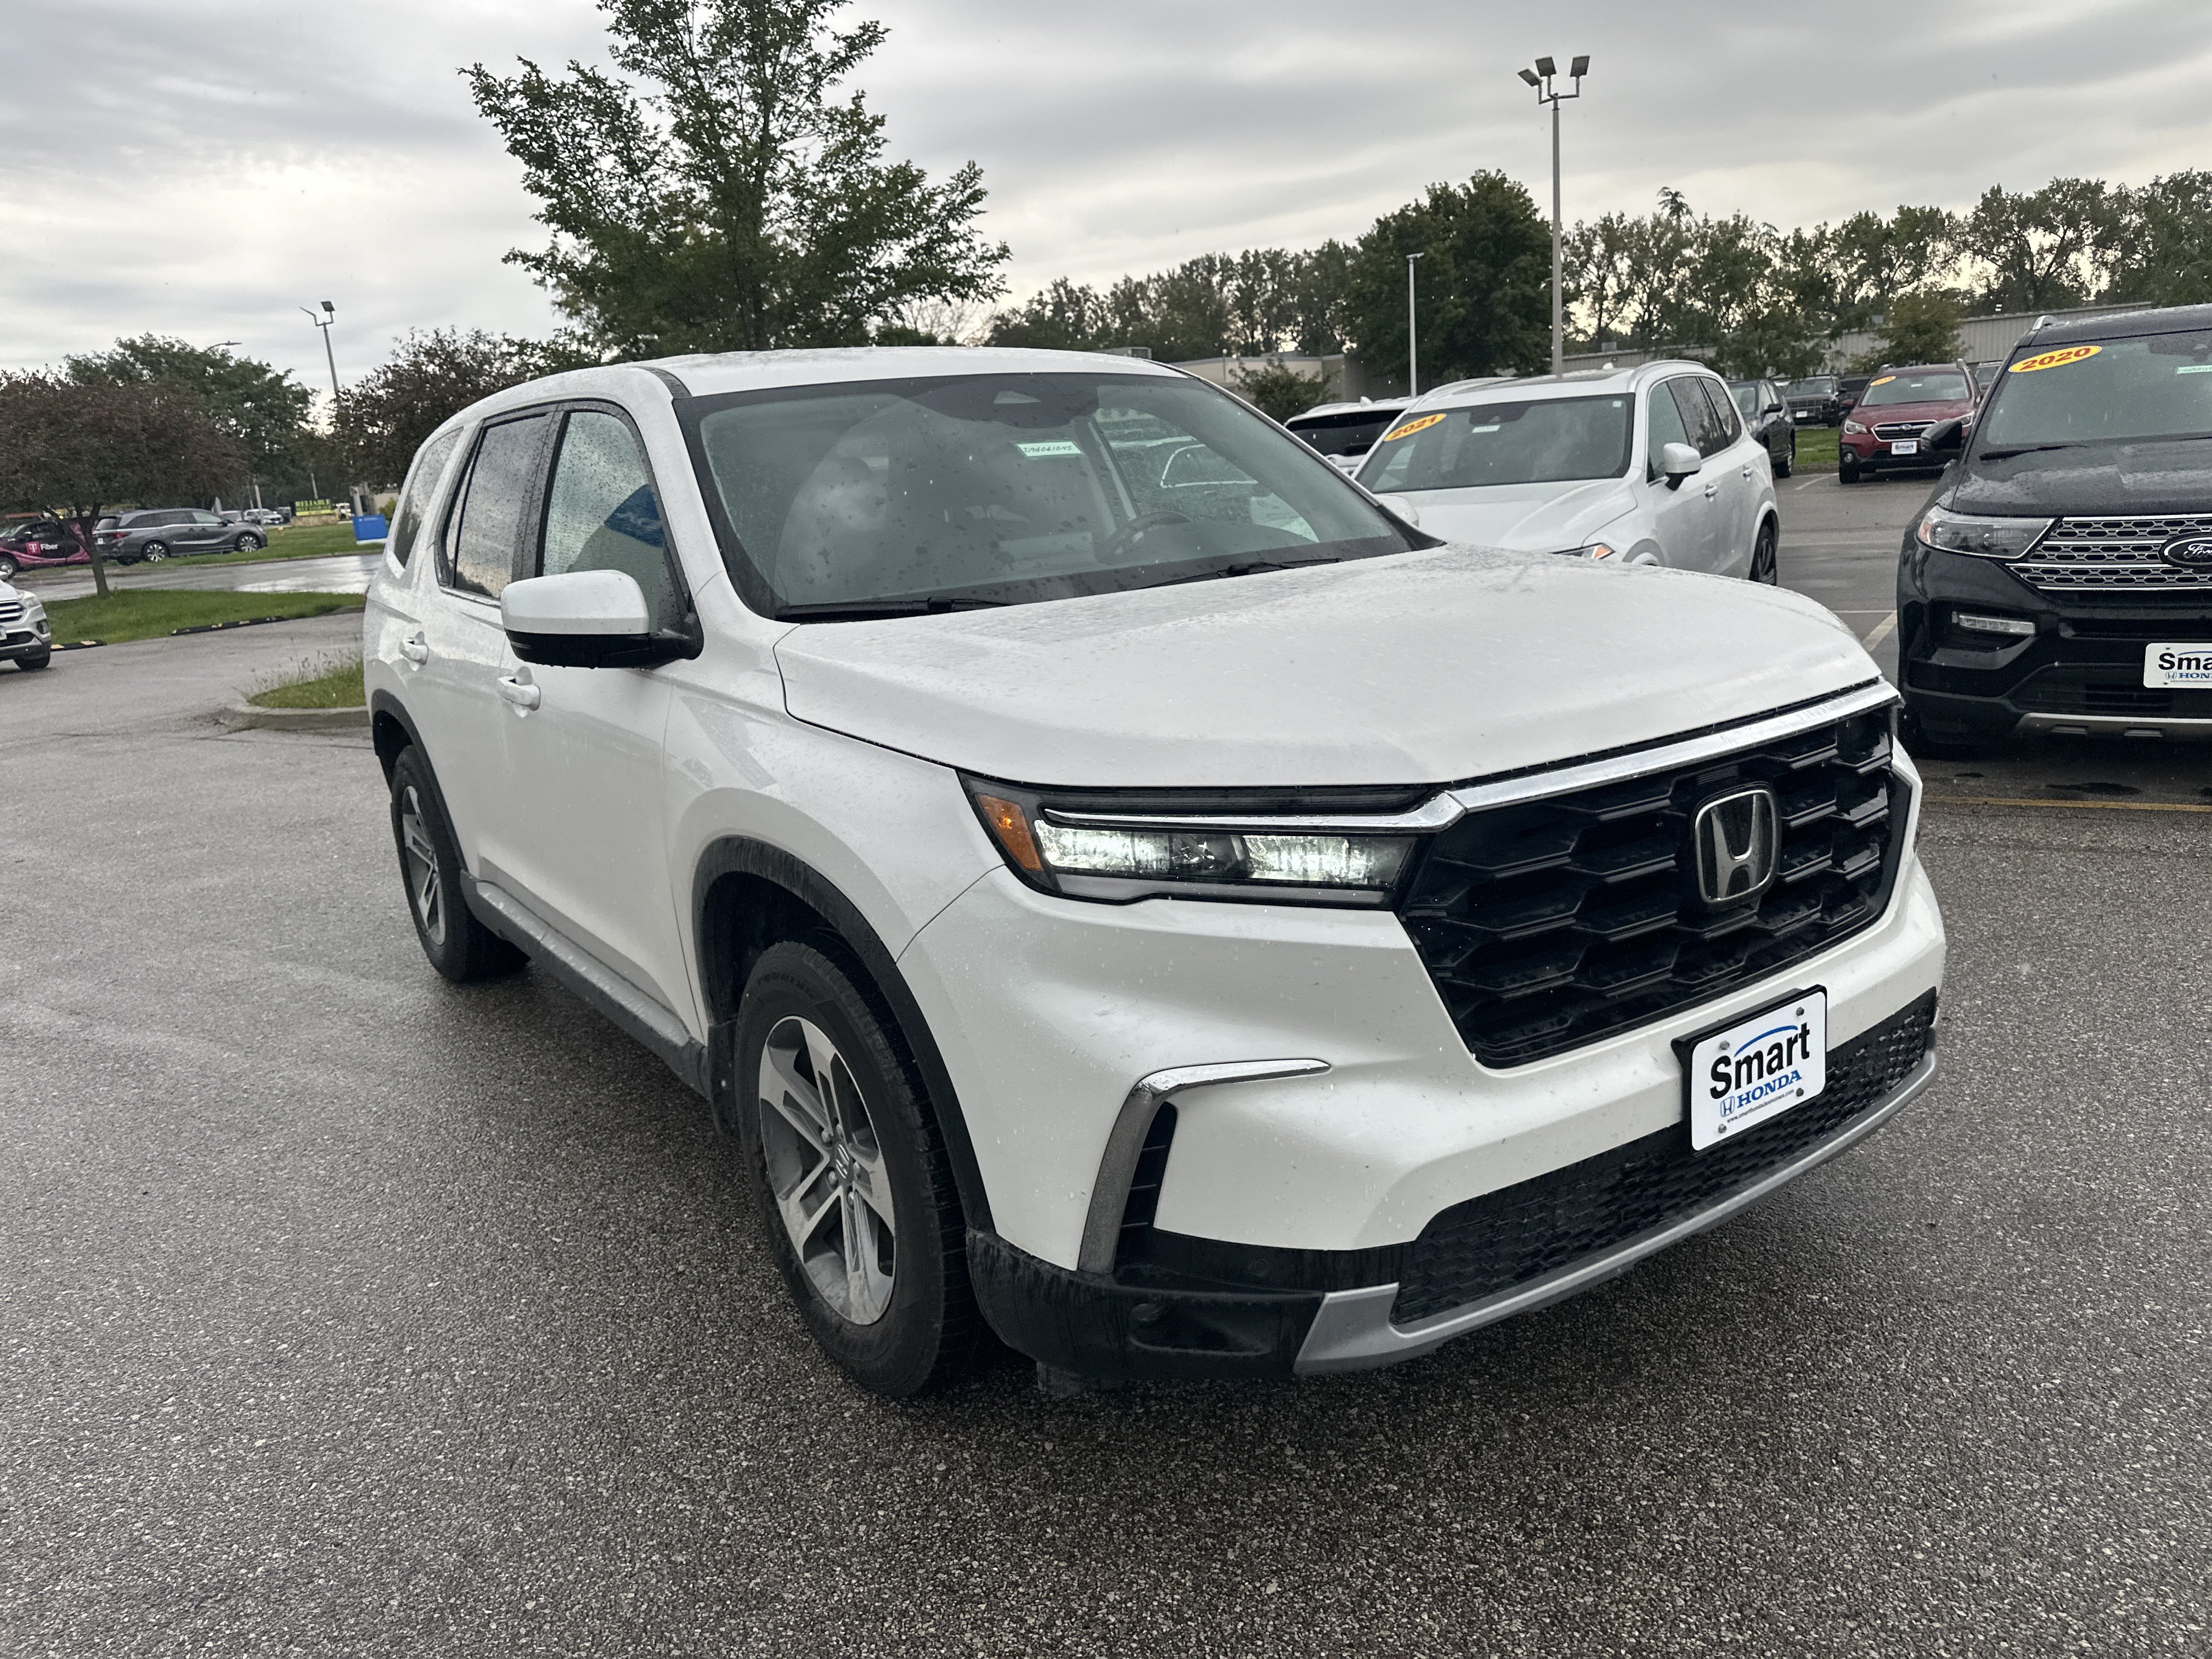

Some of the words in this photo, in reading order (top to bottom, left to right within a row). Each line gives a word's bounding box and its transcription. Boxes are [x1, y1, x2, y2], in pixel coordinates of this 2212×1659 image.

[2020, 347, 2091, 371] 2020
[1391, 415, 1437, 438] 2021
[1709, 1023, 1810, 1099] Smart
[1737, 1070, 1802, 1108] HONDA
